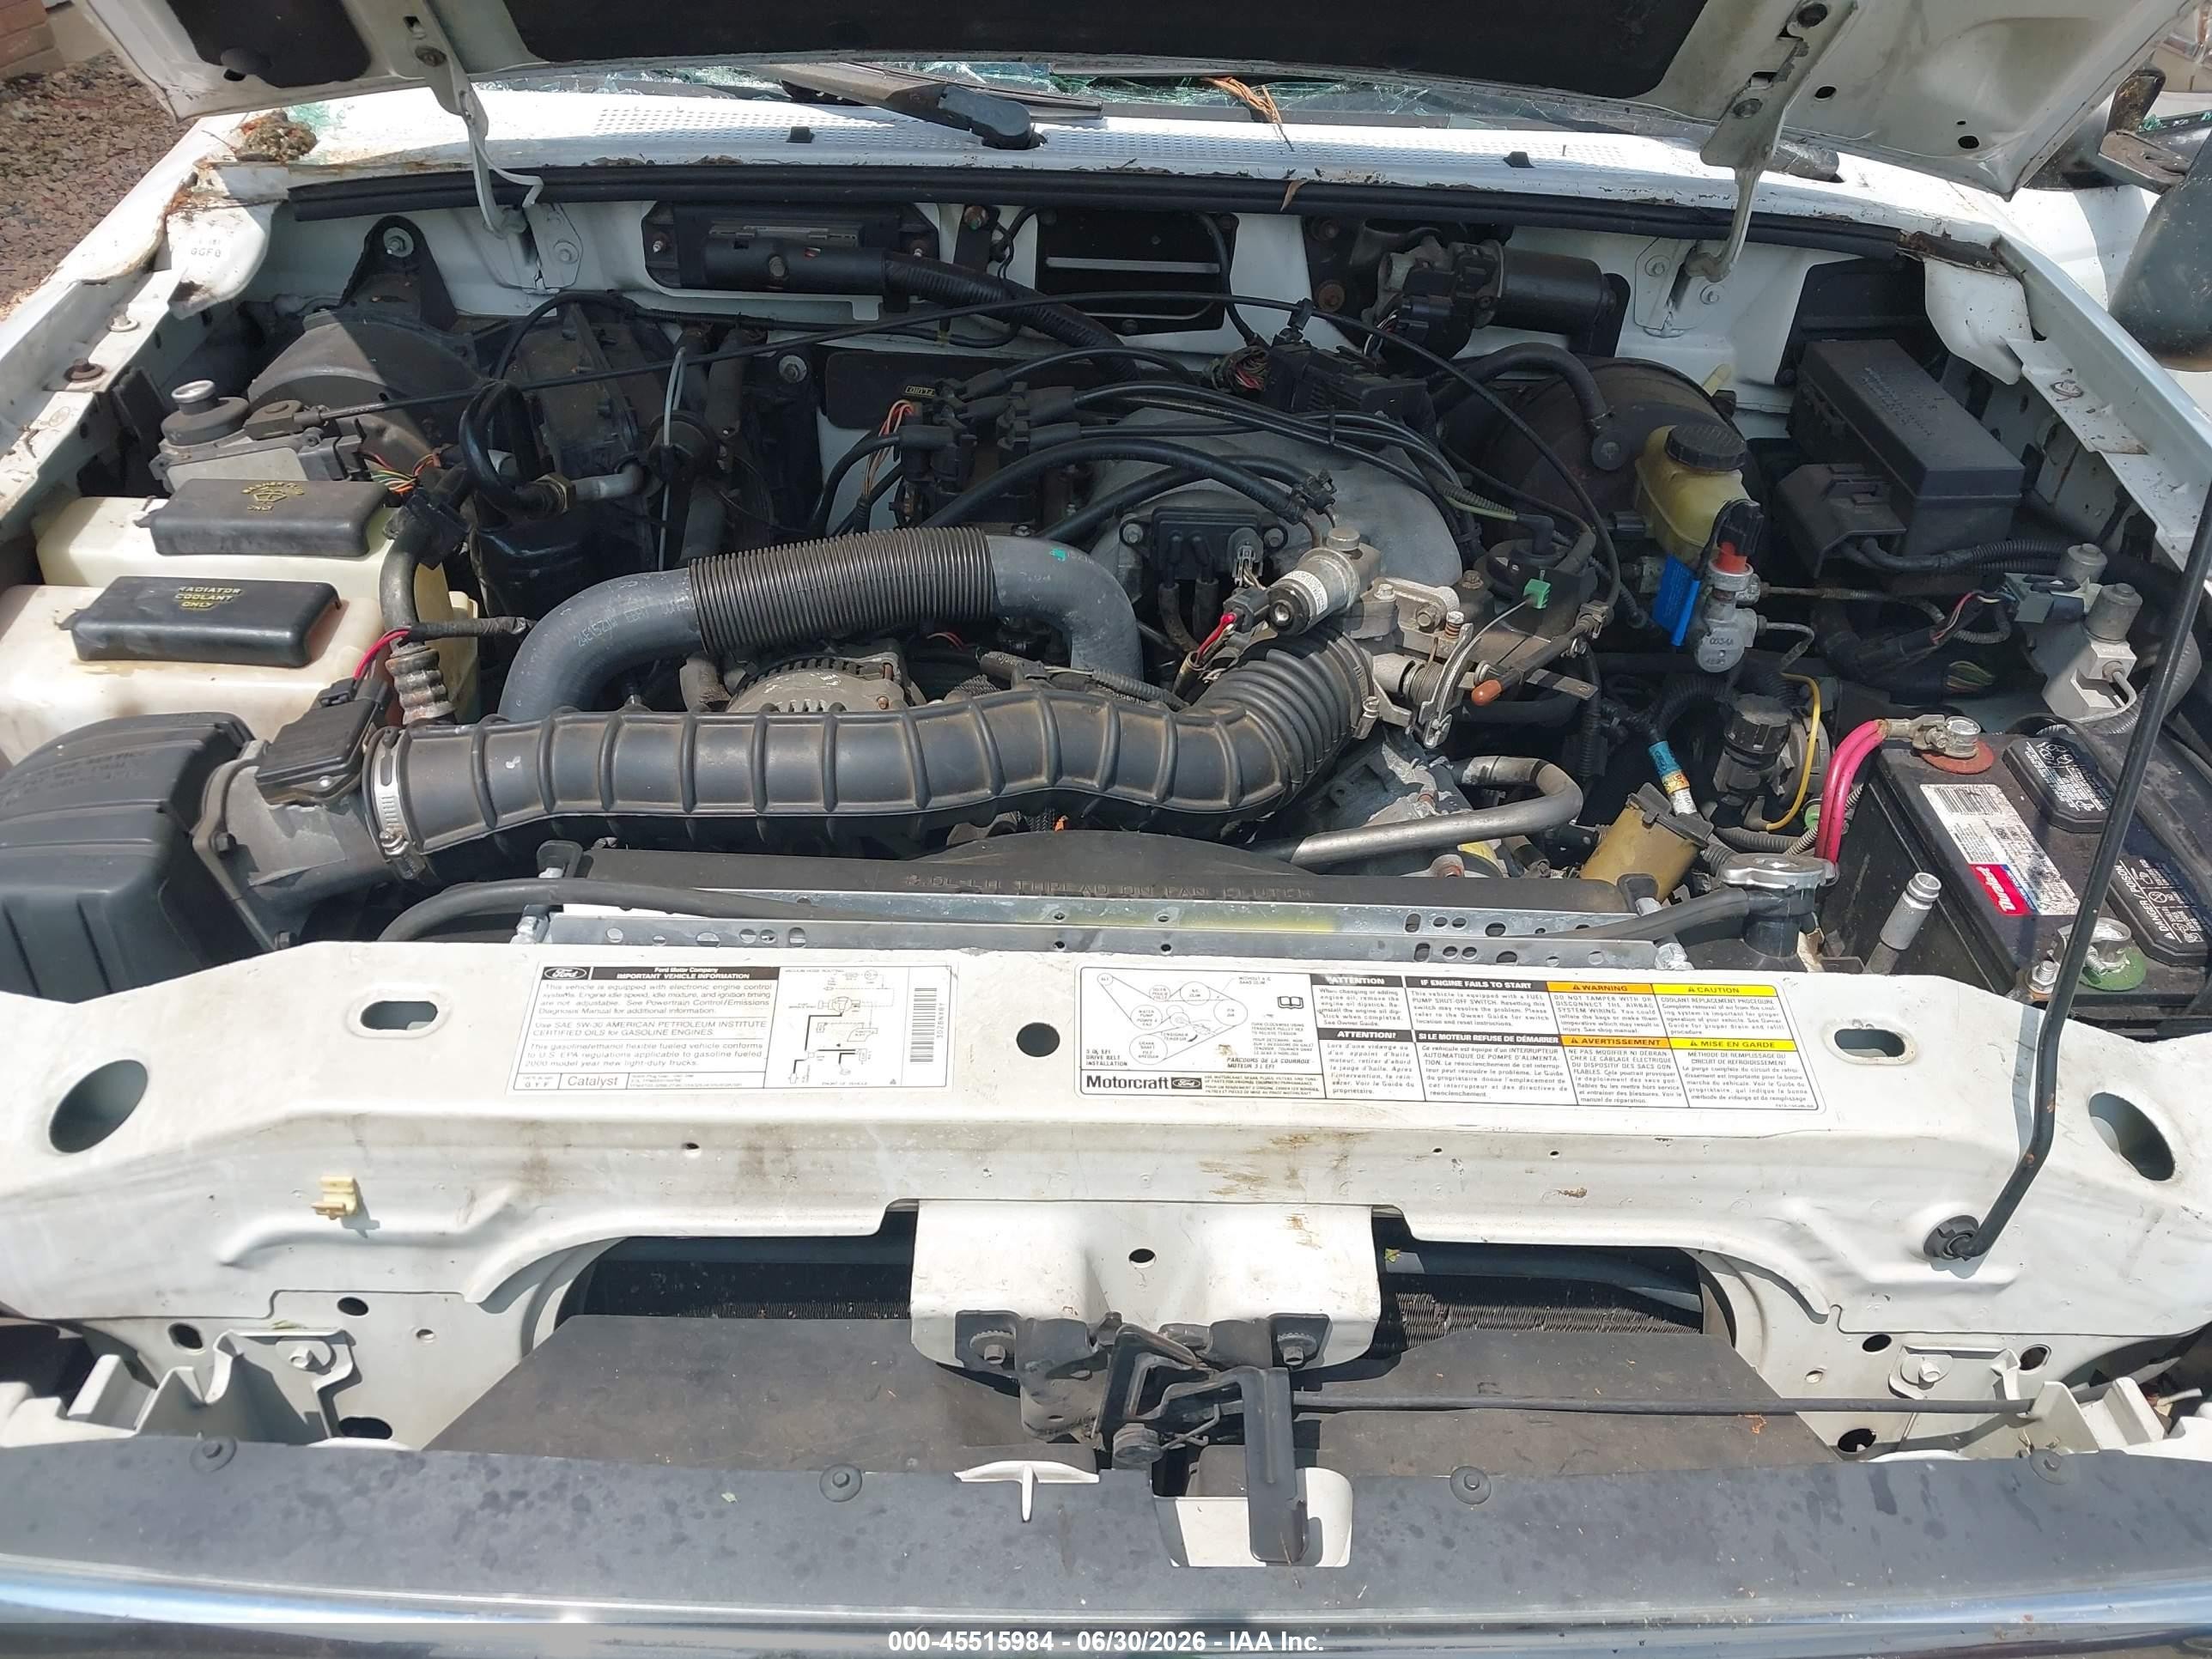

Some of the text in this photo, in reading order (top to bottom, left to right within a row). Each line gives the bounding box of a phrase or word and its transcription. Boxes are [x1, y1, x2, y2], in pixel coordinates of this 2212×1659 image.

[178, 586, 243, 595] RADIATOR
[174, 593, 235, 602] COOLANT
[180, 601, 216, 610] ONLY
[2114, 865, 2141, 894] POISON
[1976, 866, 2016, 912] Duralast
[2139, 900, 2170, 932] DANGER
[550, 968, 581, 979] Ford
[568, 1076, 618, 1088] Catalyst
[1086, 1075, 1169, 1090] Motorcraft
